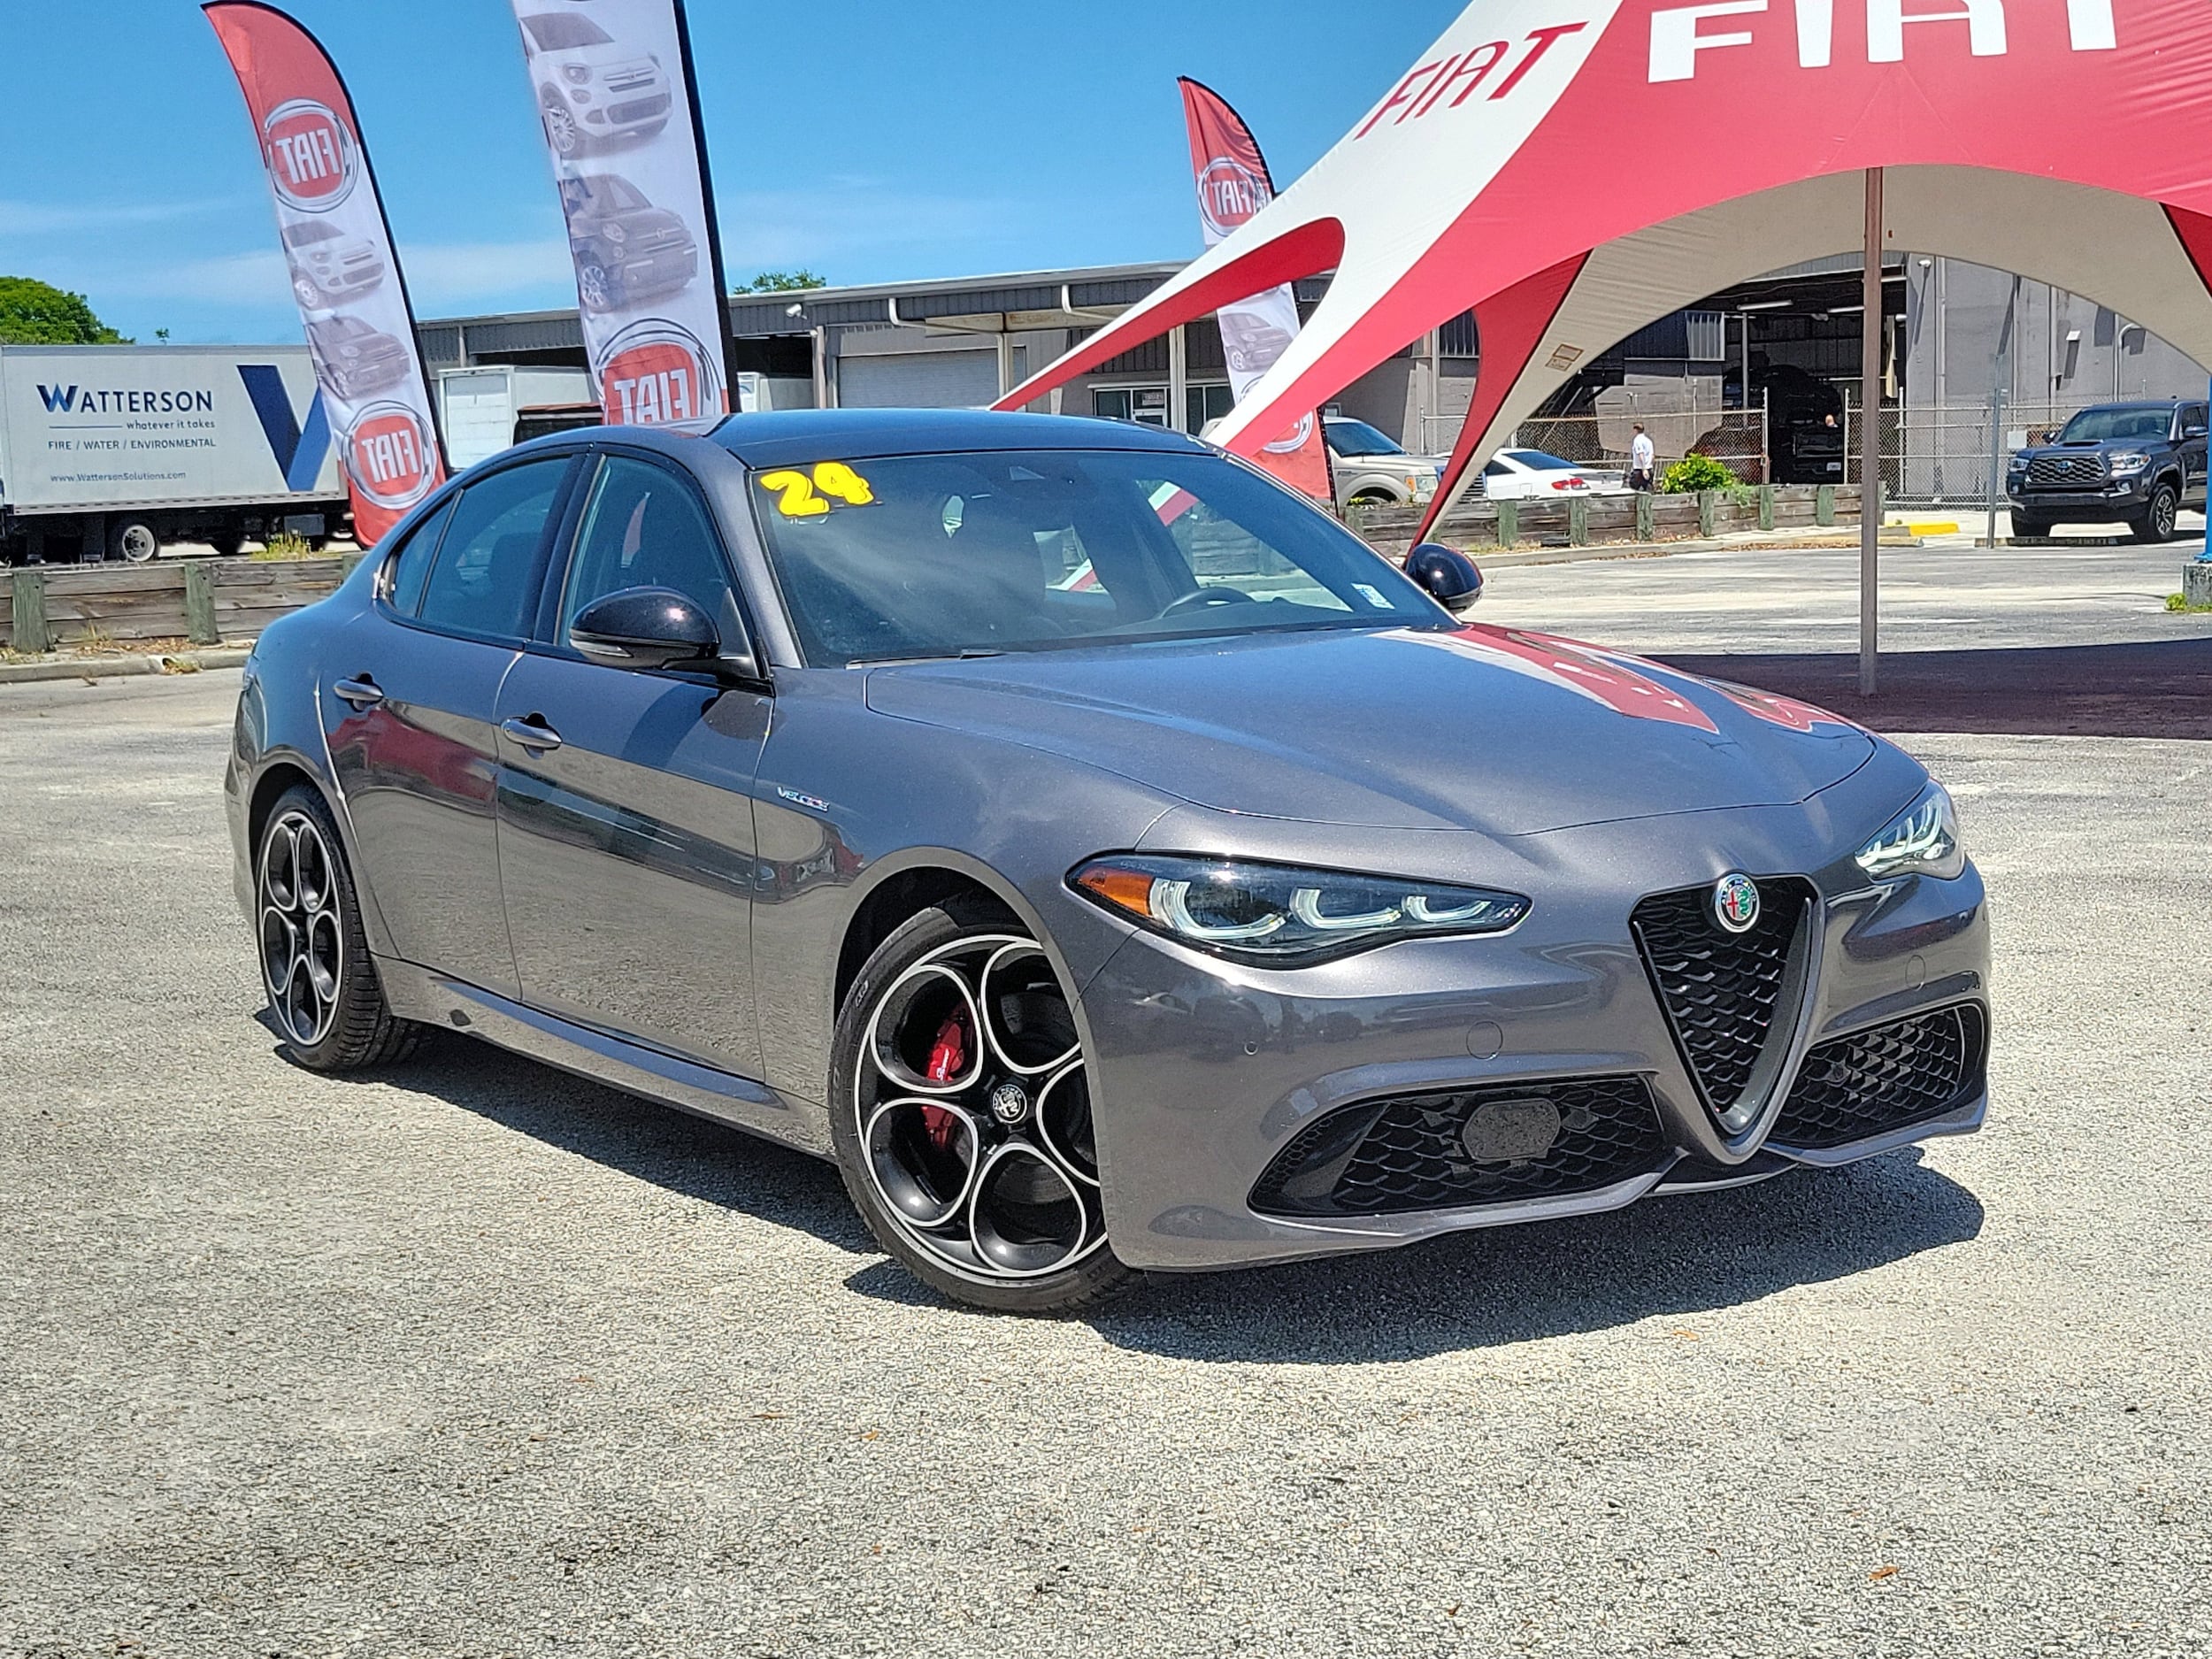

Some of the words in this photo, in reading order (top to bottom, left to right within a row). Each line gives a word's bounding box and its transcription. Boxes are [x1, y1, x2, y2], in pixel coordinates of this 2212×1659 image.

[1353, 20, 1590, 142] FIAT
[36, 382, 213, 413] WATTERSON
[127, 419, 174, 430] whatever
[177, 419, 185, 429] it
[188, 419, 216, 429] takes
[48, 441, 72, 450] FIRE
[83, 441, 119, 449] WATER
[130, 438, 217, 449] ENVIRONMENTAL
[50, 472, 186, 482] www.WattersonSolutions.com
[760, 462, 875, 516] 24
